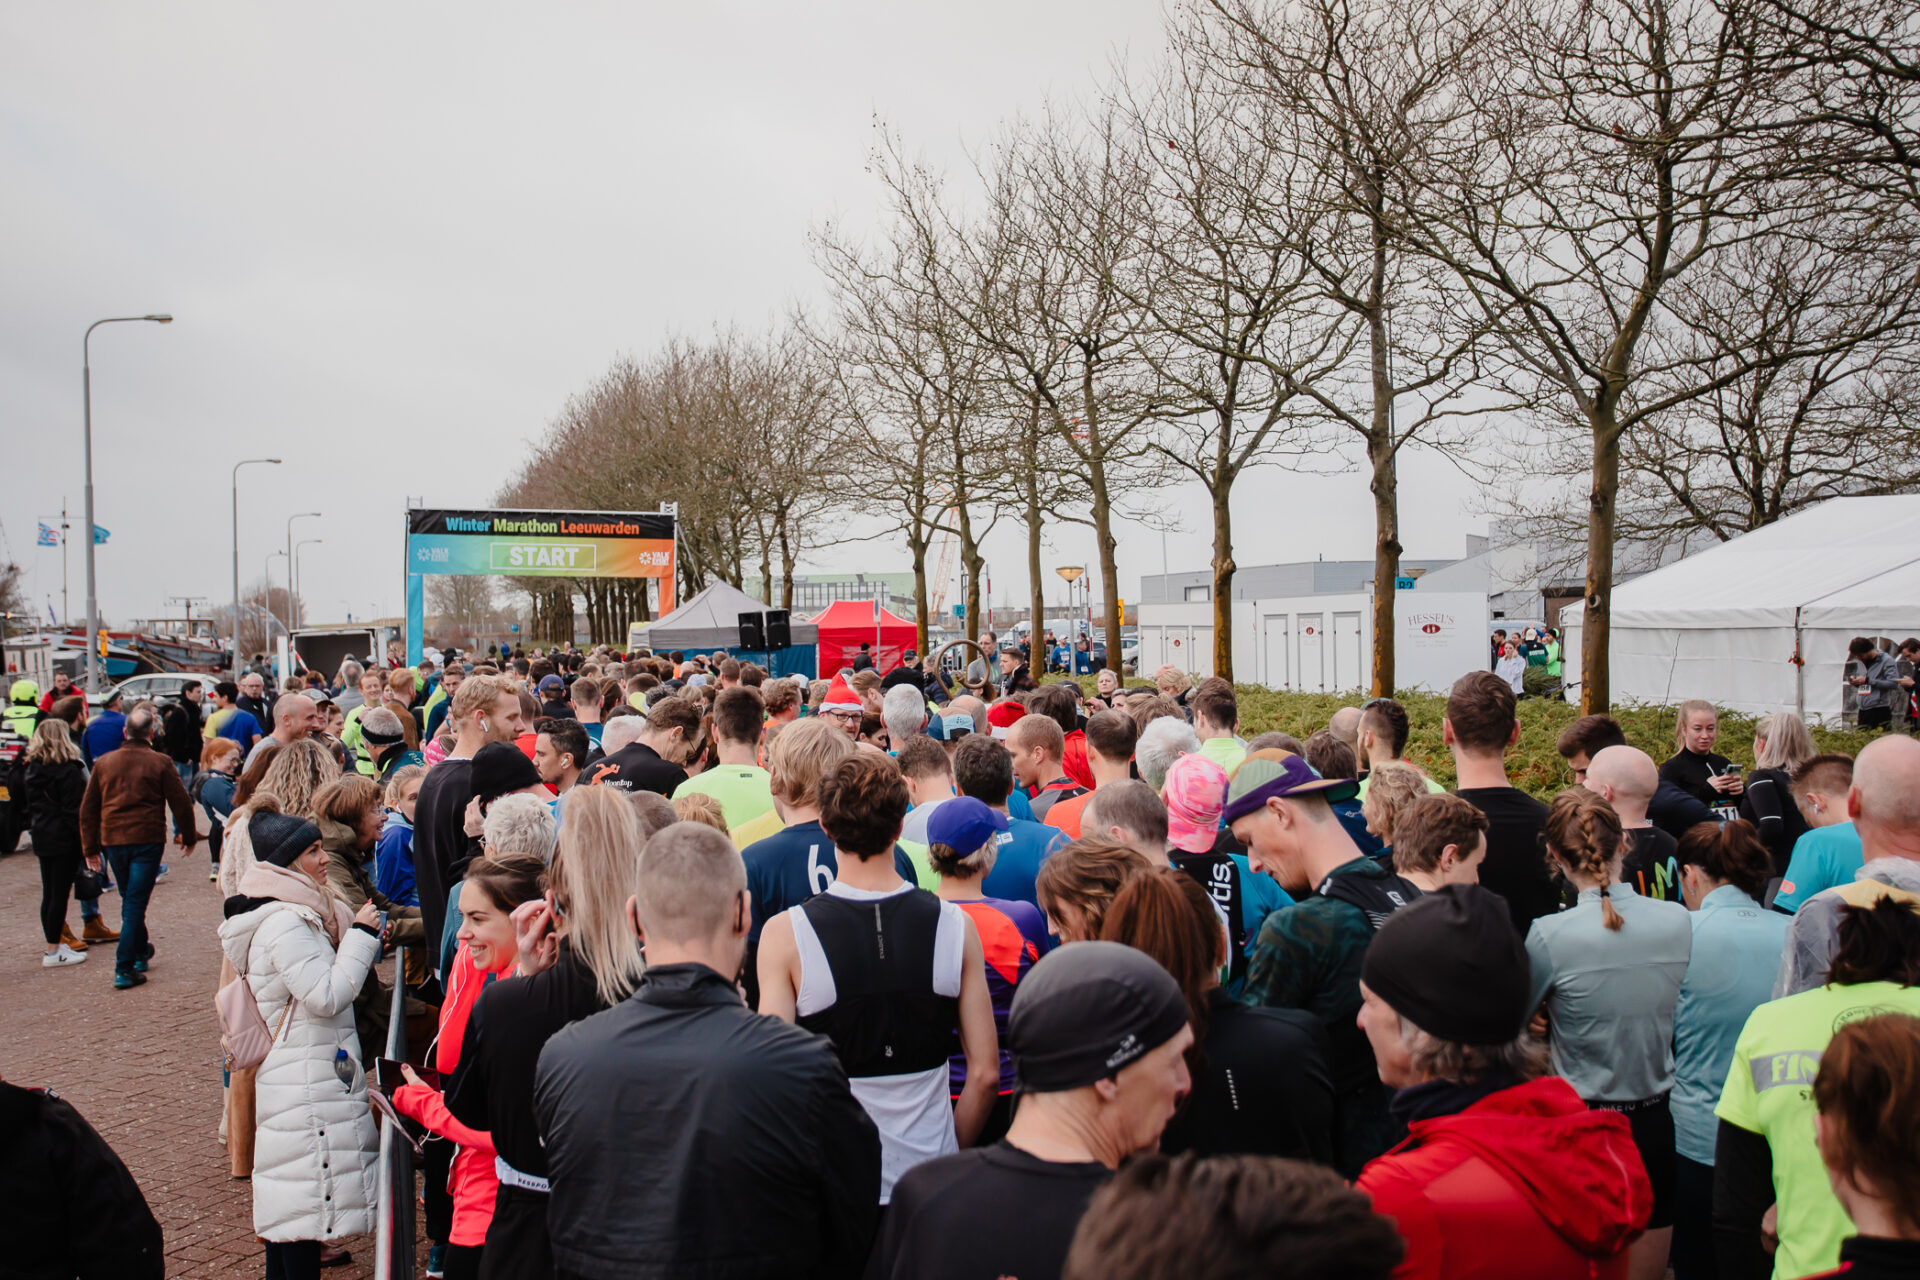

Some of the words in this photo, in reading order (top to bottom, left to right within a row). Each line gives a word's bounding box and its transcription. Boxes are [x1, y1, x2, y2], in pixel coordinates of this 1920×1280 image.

[445, 517, 491, 532] Winter
[493, 518, 558, 533] Marathon
[560, 519, 640, 535] Leeuwarden
[509, 546, 579, 566] START
[1407, 612, 1457, 626] HESSEL'S
